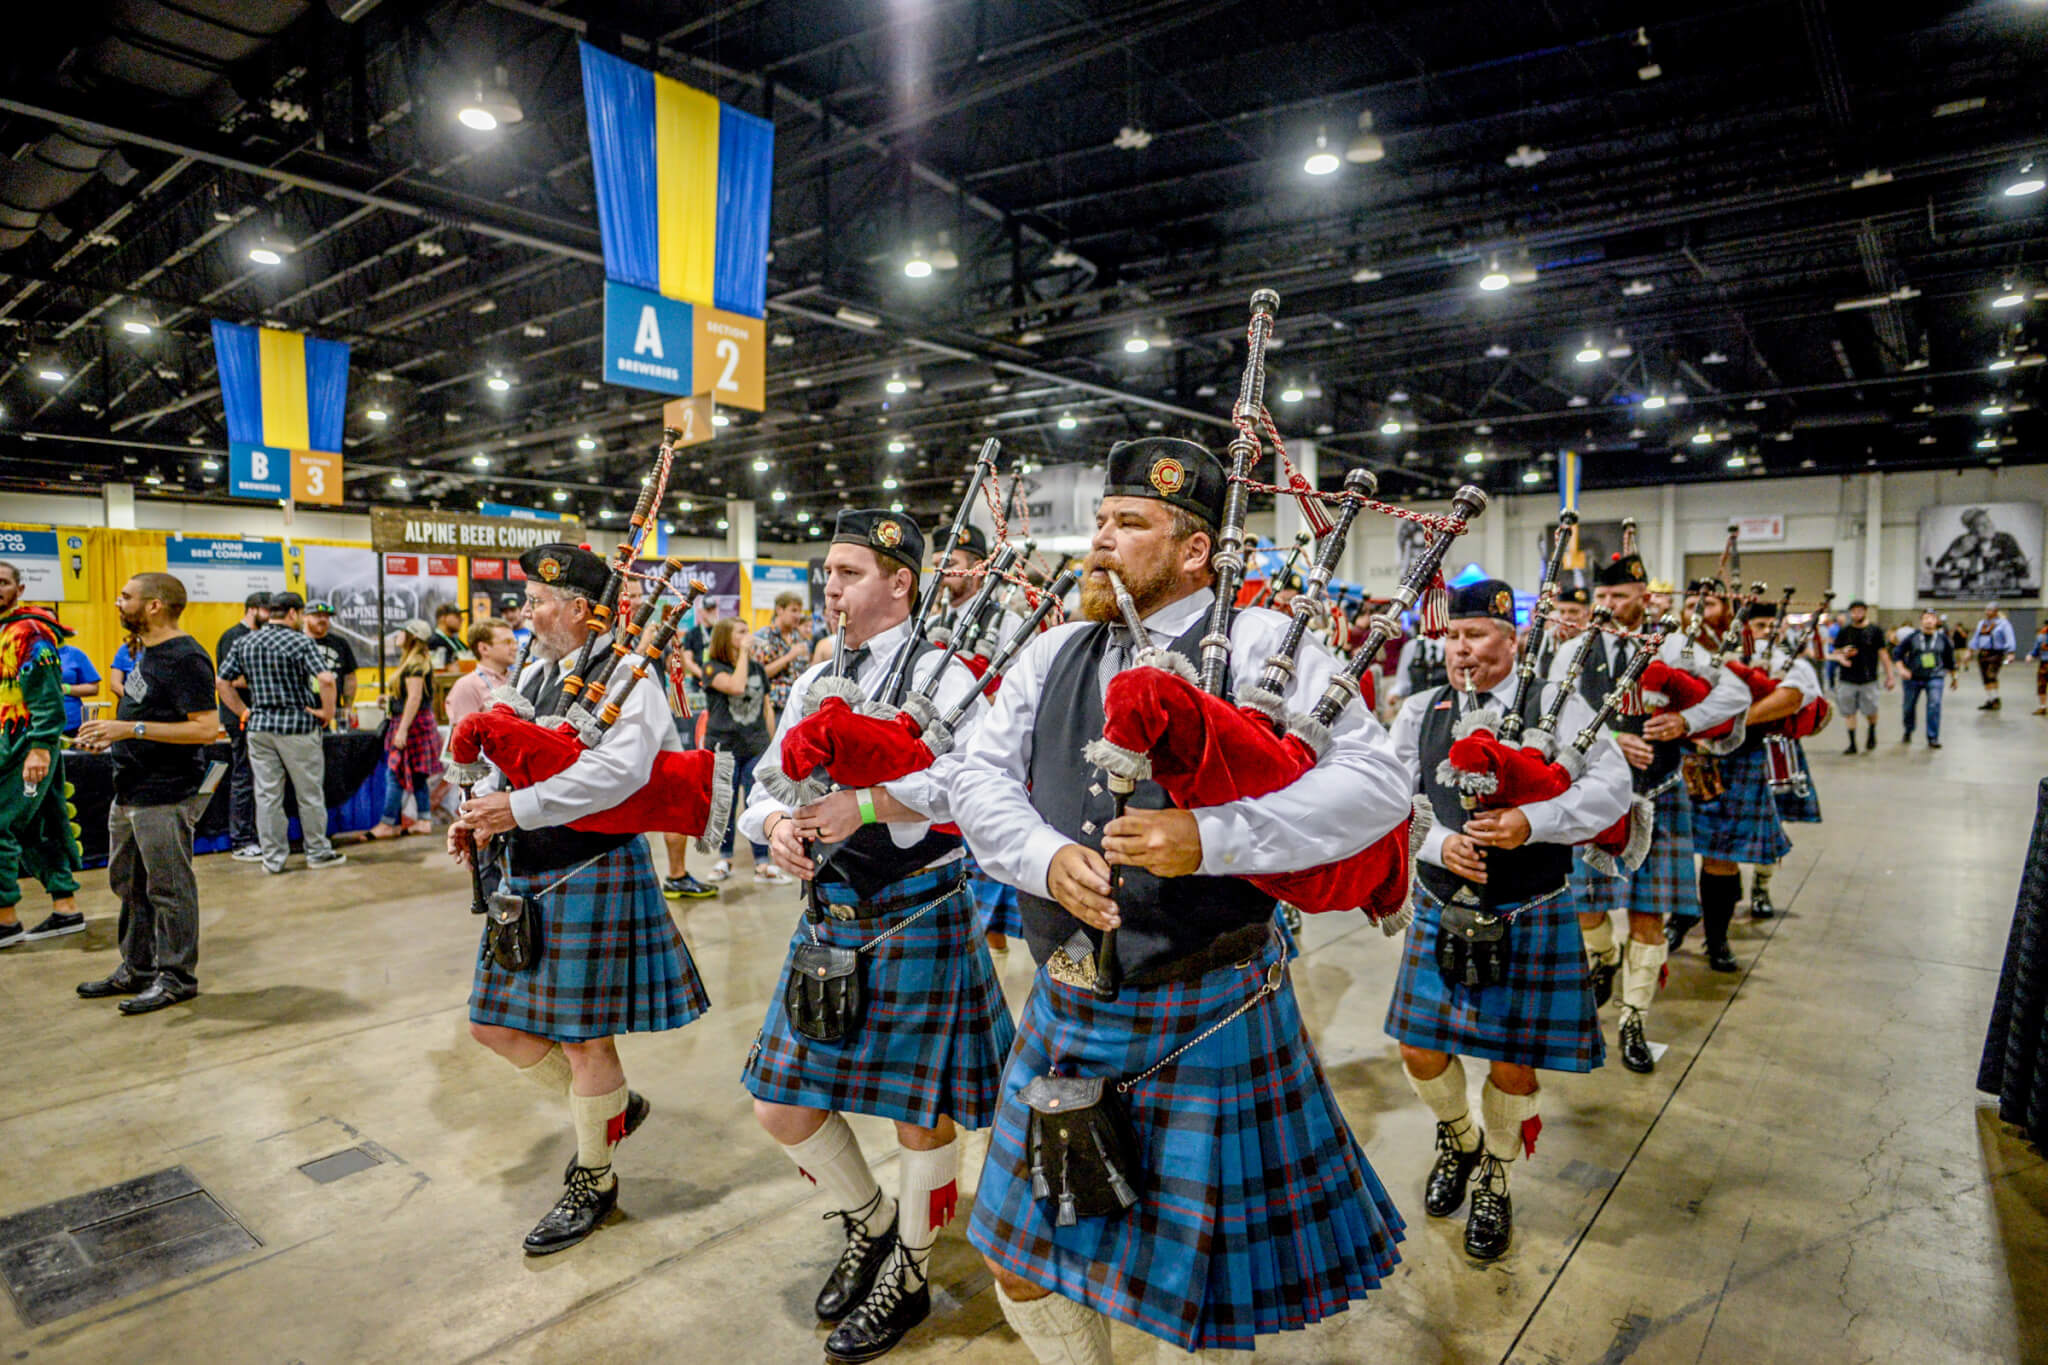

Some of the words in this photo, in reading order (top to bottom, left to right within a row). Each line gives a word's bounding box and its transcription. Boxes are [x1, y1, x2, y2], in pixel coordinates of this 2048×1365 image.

[634, 305, 664, 359] A
[706, 320, 749, 341] SECTION
[617, 357, 679, 381] BREWERIES
[715, 339, 739, 392] 2
[251, 451, 269, 480] B
[306, 466, 325, 496] 3
[405, 520, 456, 545] ALPINE
[460, 523, 496, 547] BEER
[498, 526, 562, 548] COMPANY
[8, 543, 26, 552] CO
[191, 549, 213, 558] BEER
[216, 551, 263, 560] COMPANY
[211, 542, 243, 551] ALPINE
[341, 605, 378, 619] ALPINE
